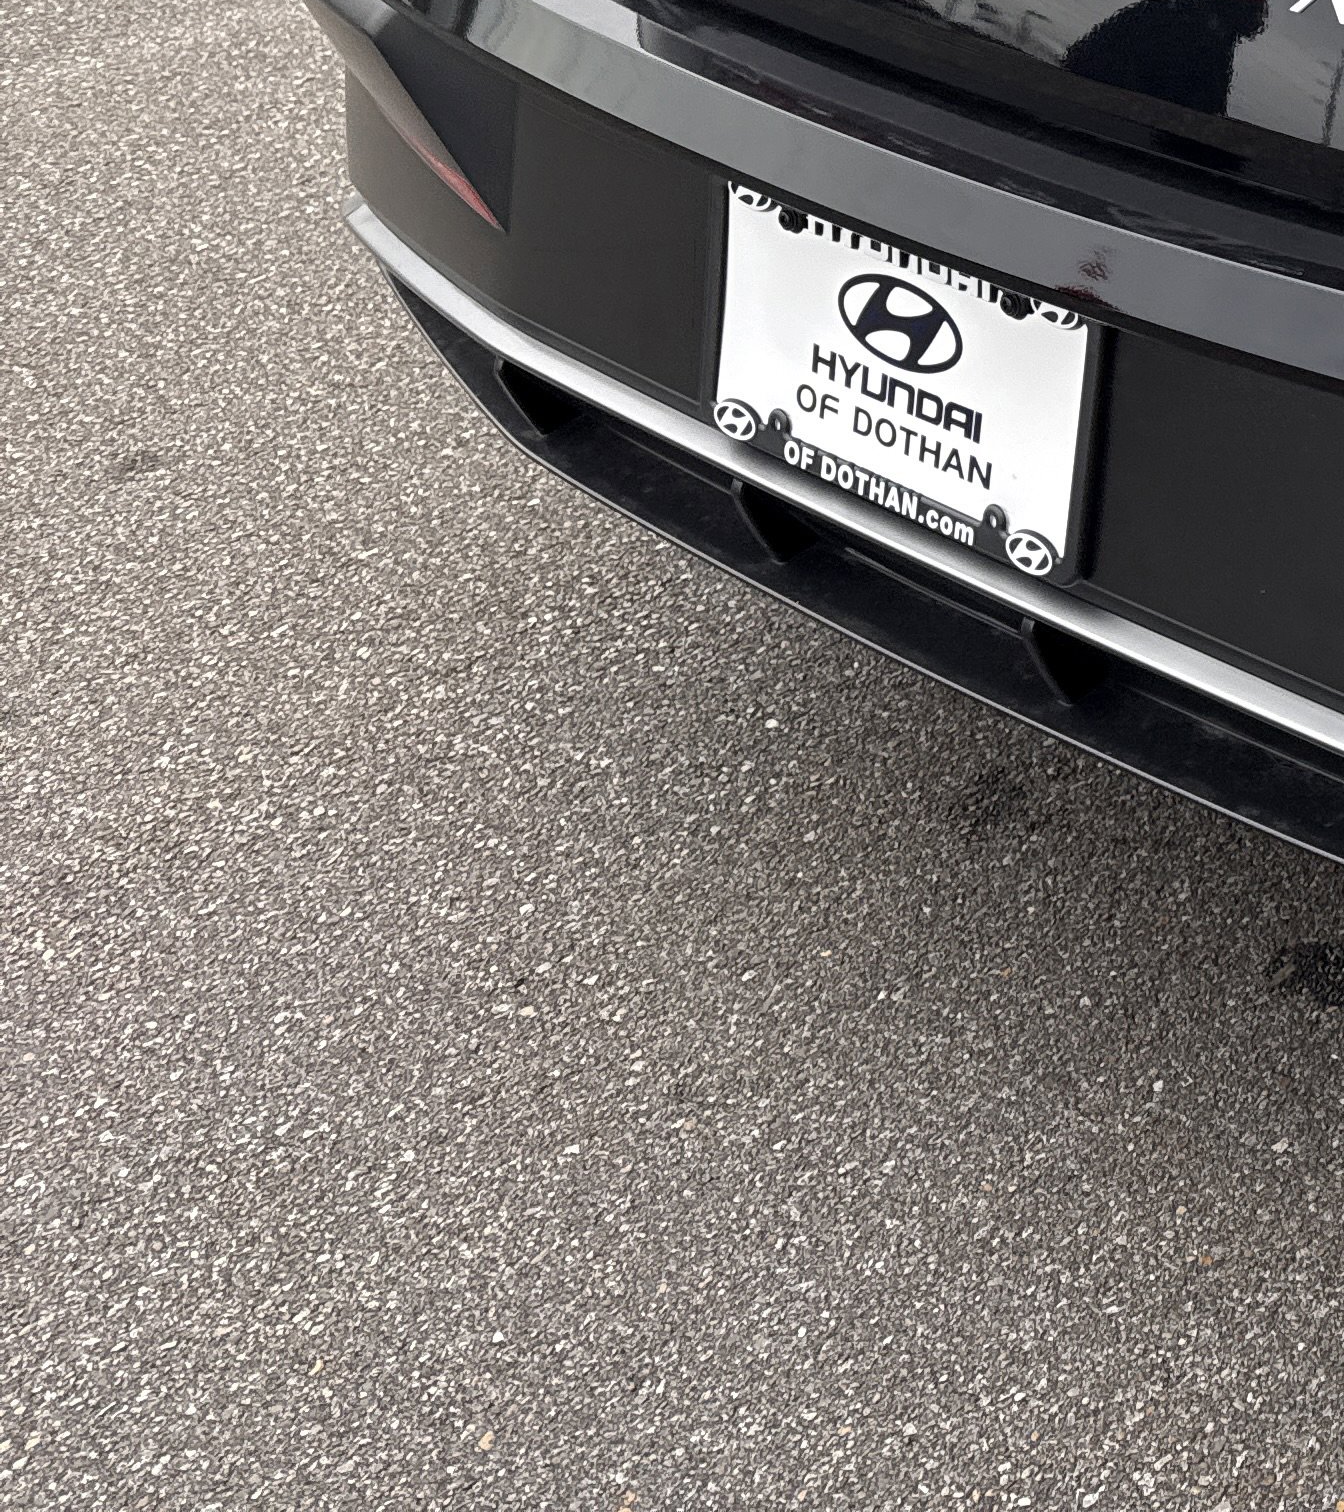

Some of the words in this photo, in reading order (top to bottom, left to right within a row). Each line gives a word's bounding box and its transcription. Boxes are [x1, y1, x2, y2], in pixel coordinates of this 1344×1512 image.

[796, 383, 840, 420] OF
[853, 406, 993, 490] DOTHAN
[811, 343, 983, 444] HYUNDAI
[783, 440, 814, 470] OF
[820, 454, 975, 546] DOTHAN.com
